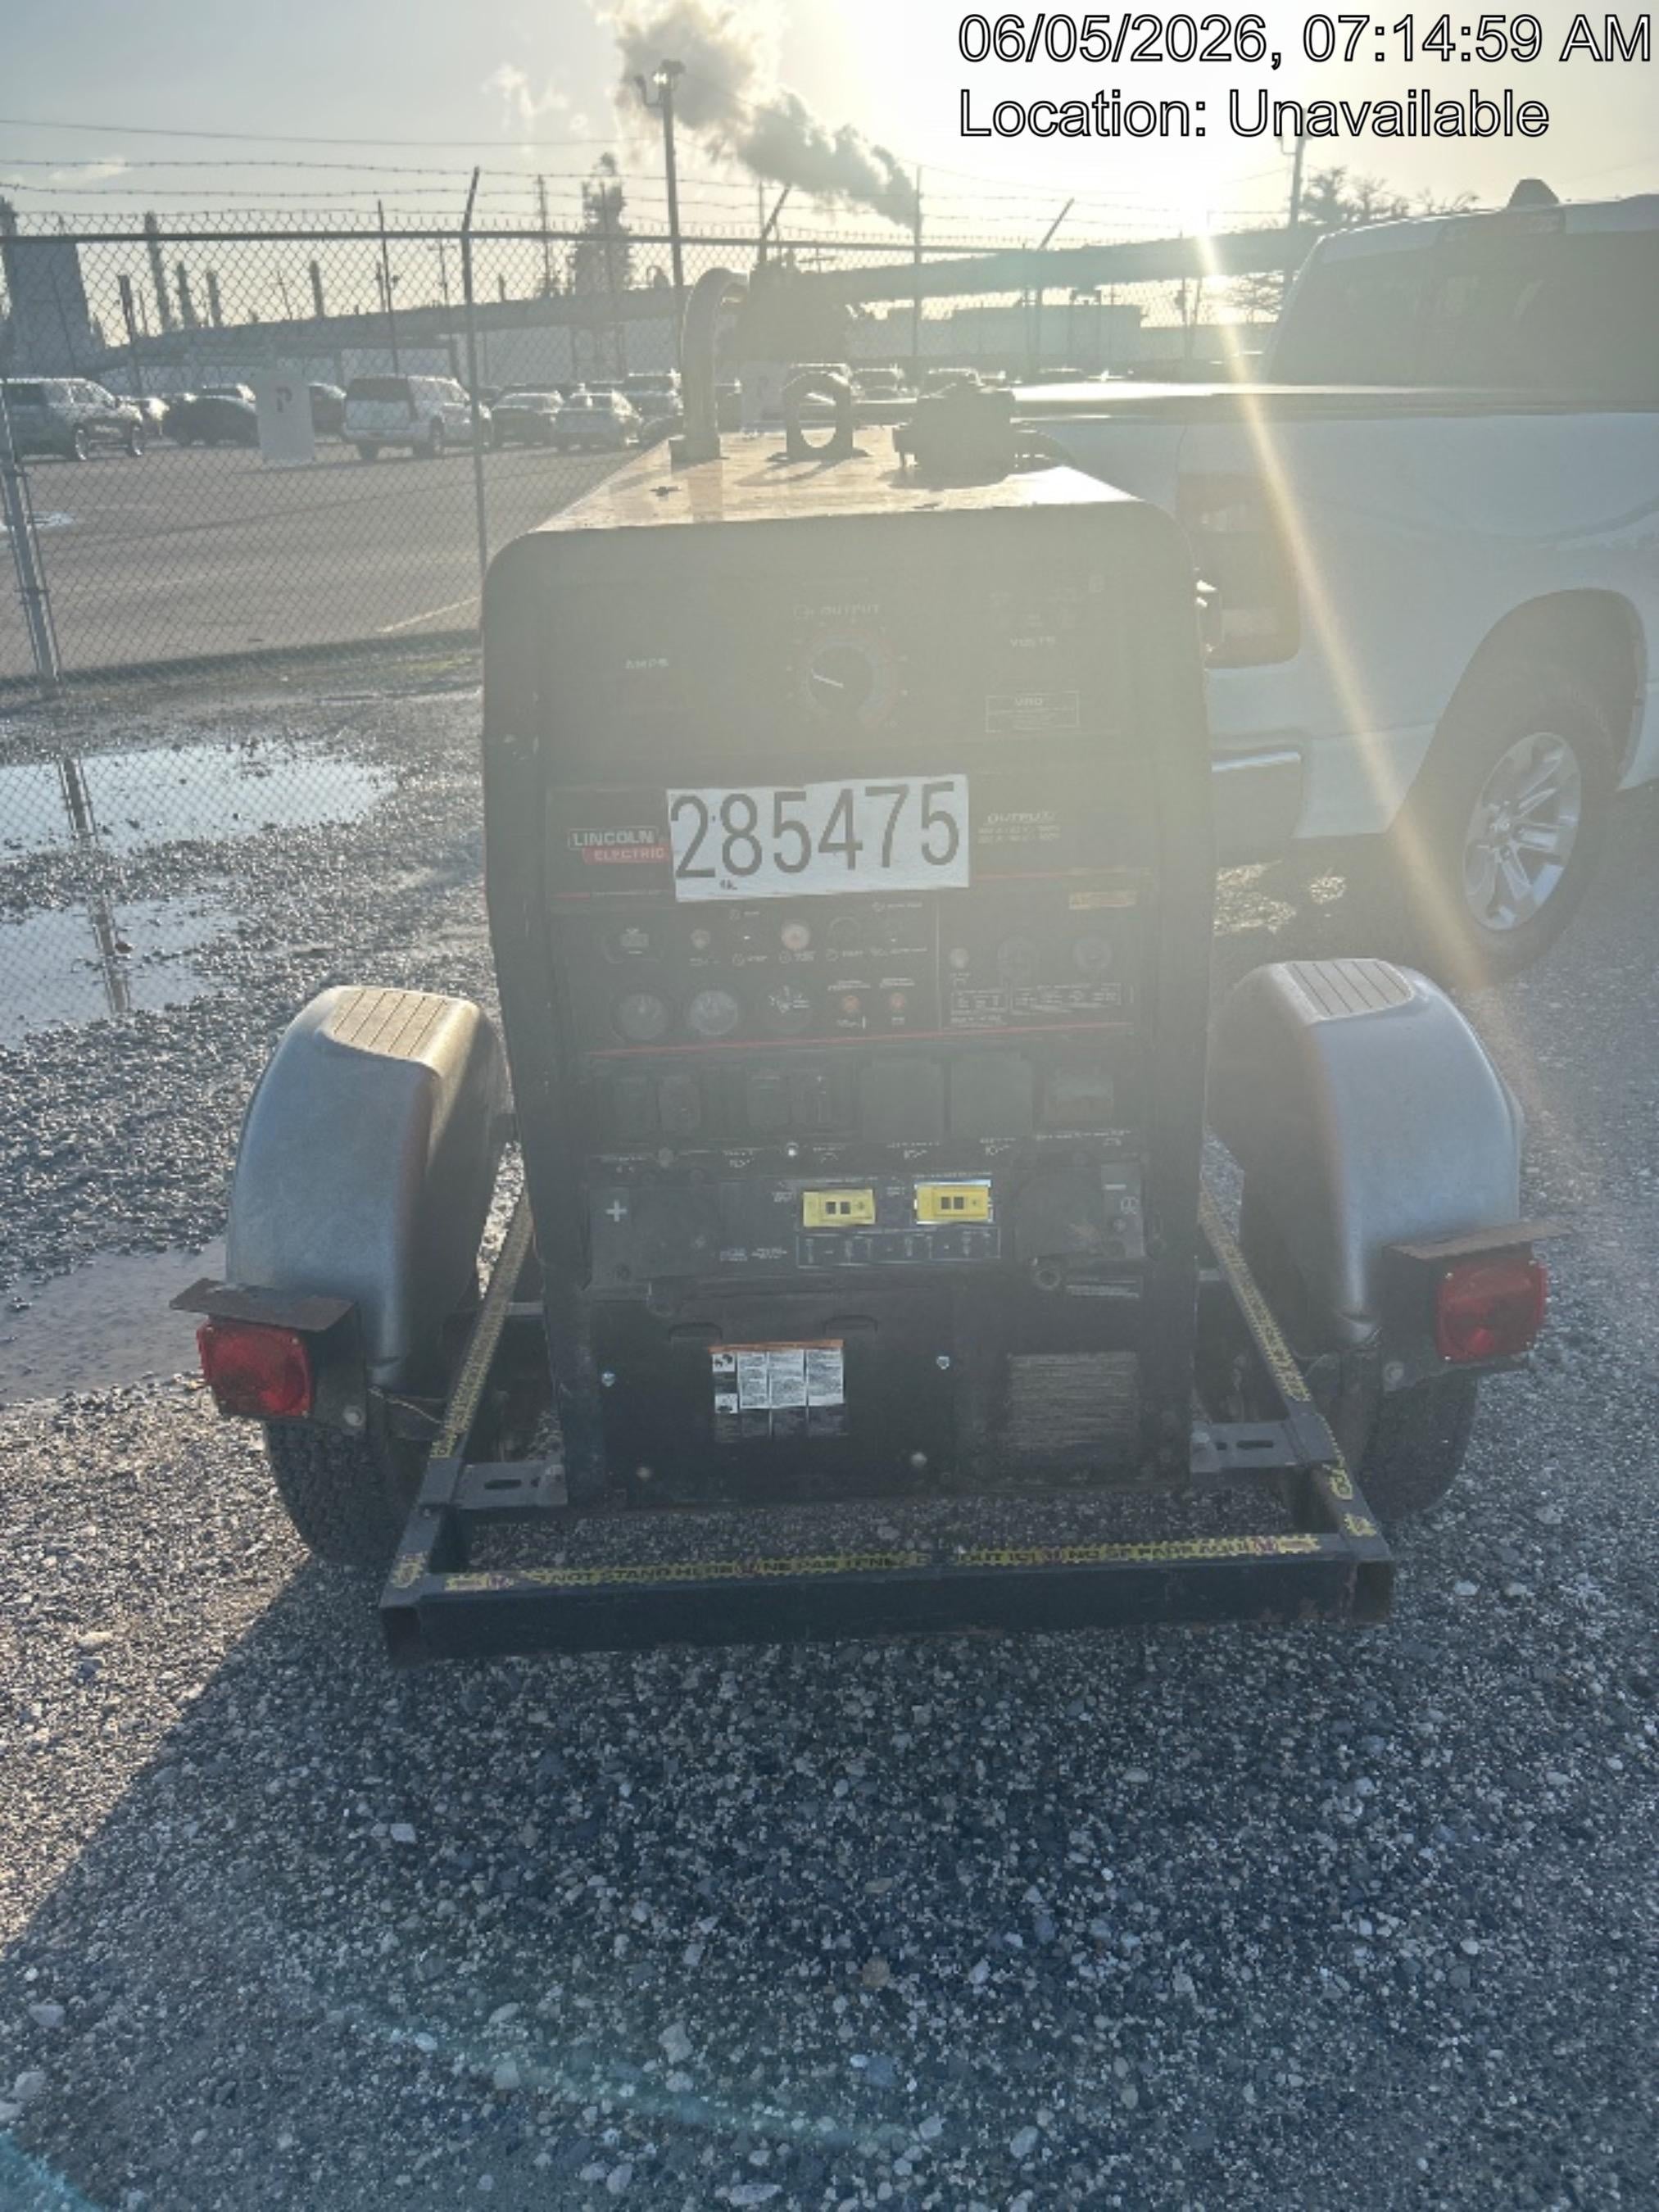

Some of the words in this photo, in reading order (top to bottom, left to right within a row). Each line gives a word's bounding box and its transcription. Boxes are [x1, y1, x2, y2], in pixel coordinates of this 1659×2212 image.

[624, 657, 669, 669] AMPS
[670, 781, 959, 878] 285475
[572, 829, 655, 847] LINCOLN
[593, 847, 664, 861] ELECTRIC
